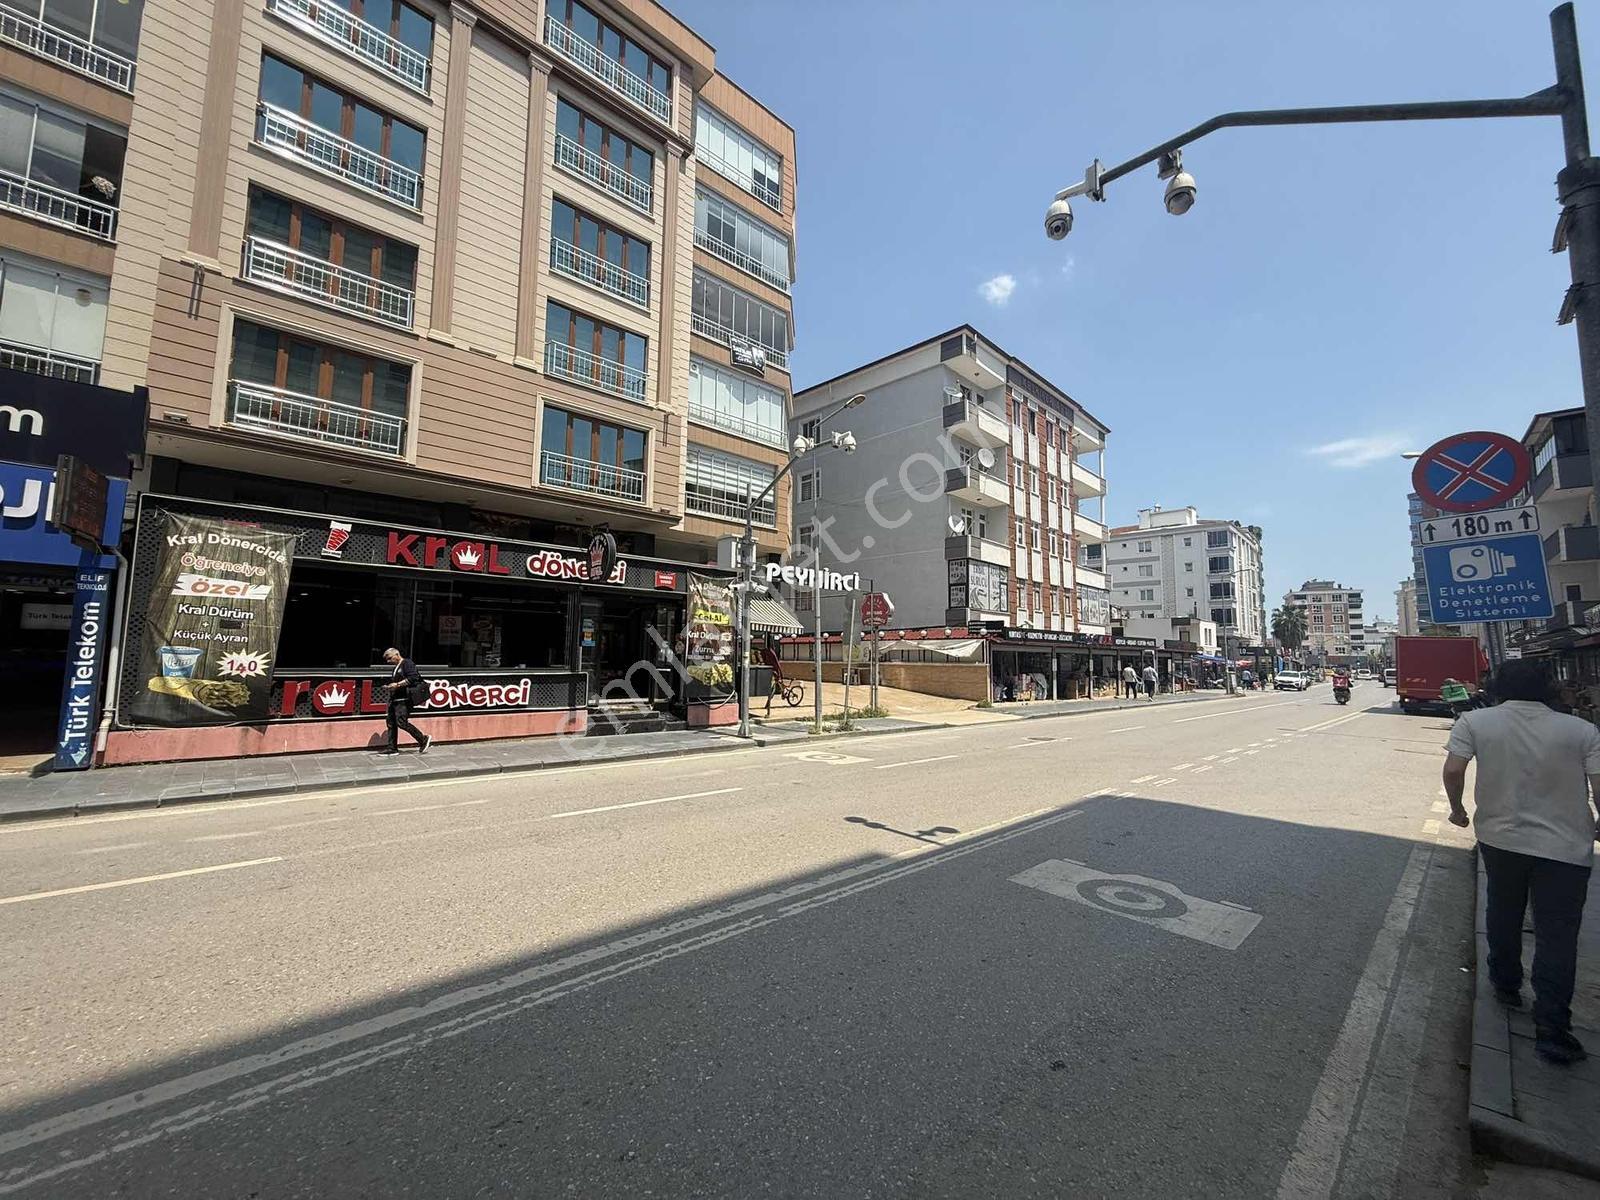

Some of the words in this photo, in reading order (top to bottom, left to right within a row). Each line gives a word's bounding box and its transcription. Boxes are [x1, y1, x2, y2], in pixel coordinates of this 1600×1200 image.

[1451, 515, 1490, 537] 180
[1494, 520, 1513, 532] m
[166, 533, 203, 547] Kral
[207, 533, 287, 564] Dönercide
[180, 552, 266, 577] Öğrenciye
[190, 578, 250, 597] Özel
[1439, 580, 1536, 597] Elektronik
[1439, 593, 1542, 608] Denetleme
[177, 603, 206, 616] Kral
[208, 605, 255, 620] Dürüm
[1455, 606, 1527, 618] Sistemi
[70, 601, 101, 689] Telekom
[173, 629, 211, 641] Küçük
[213, 631, 249, 643] Ayran
[226, 660, 258, 674] 140
[64, 694, 91, 743] Türk
